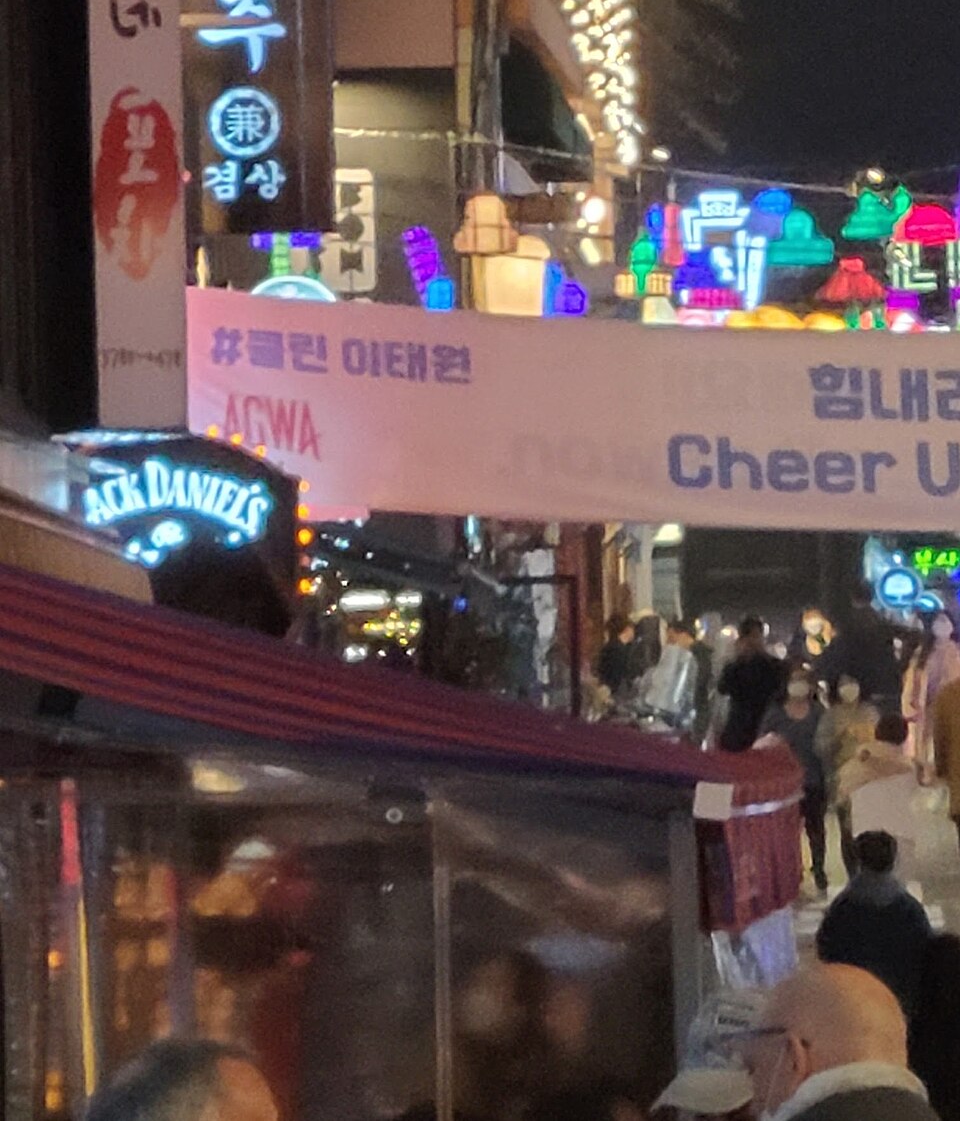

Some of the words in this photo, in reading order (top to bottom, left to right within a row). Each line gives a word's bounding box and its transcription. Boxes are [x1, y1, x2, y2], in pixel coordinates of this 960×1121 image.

[342, 337, 472, 384] 이태원
[667, 433, 897, 493] Cheer
[84, 472, 147, 524] ACK
